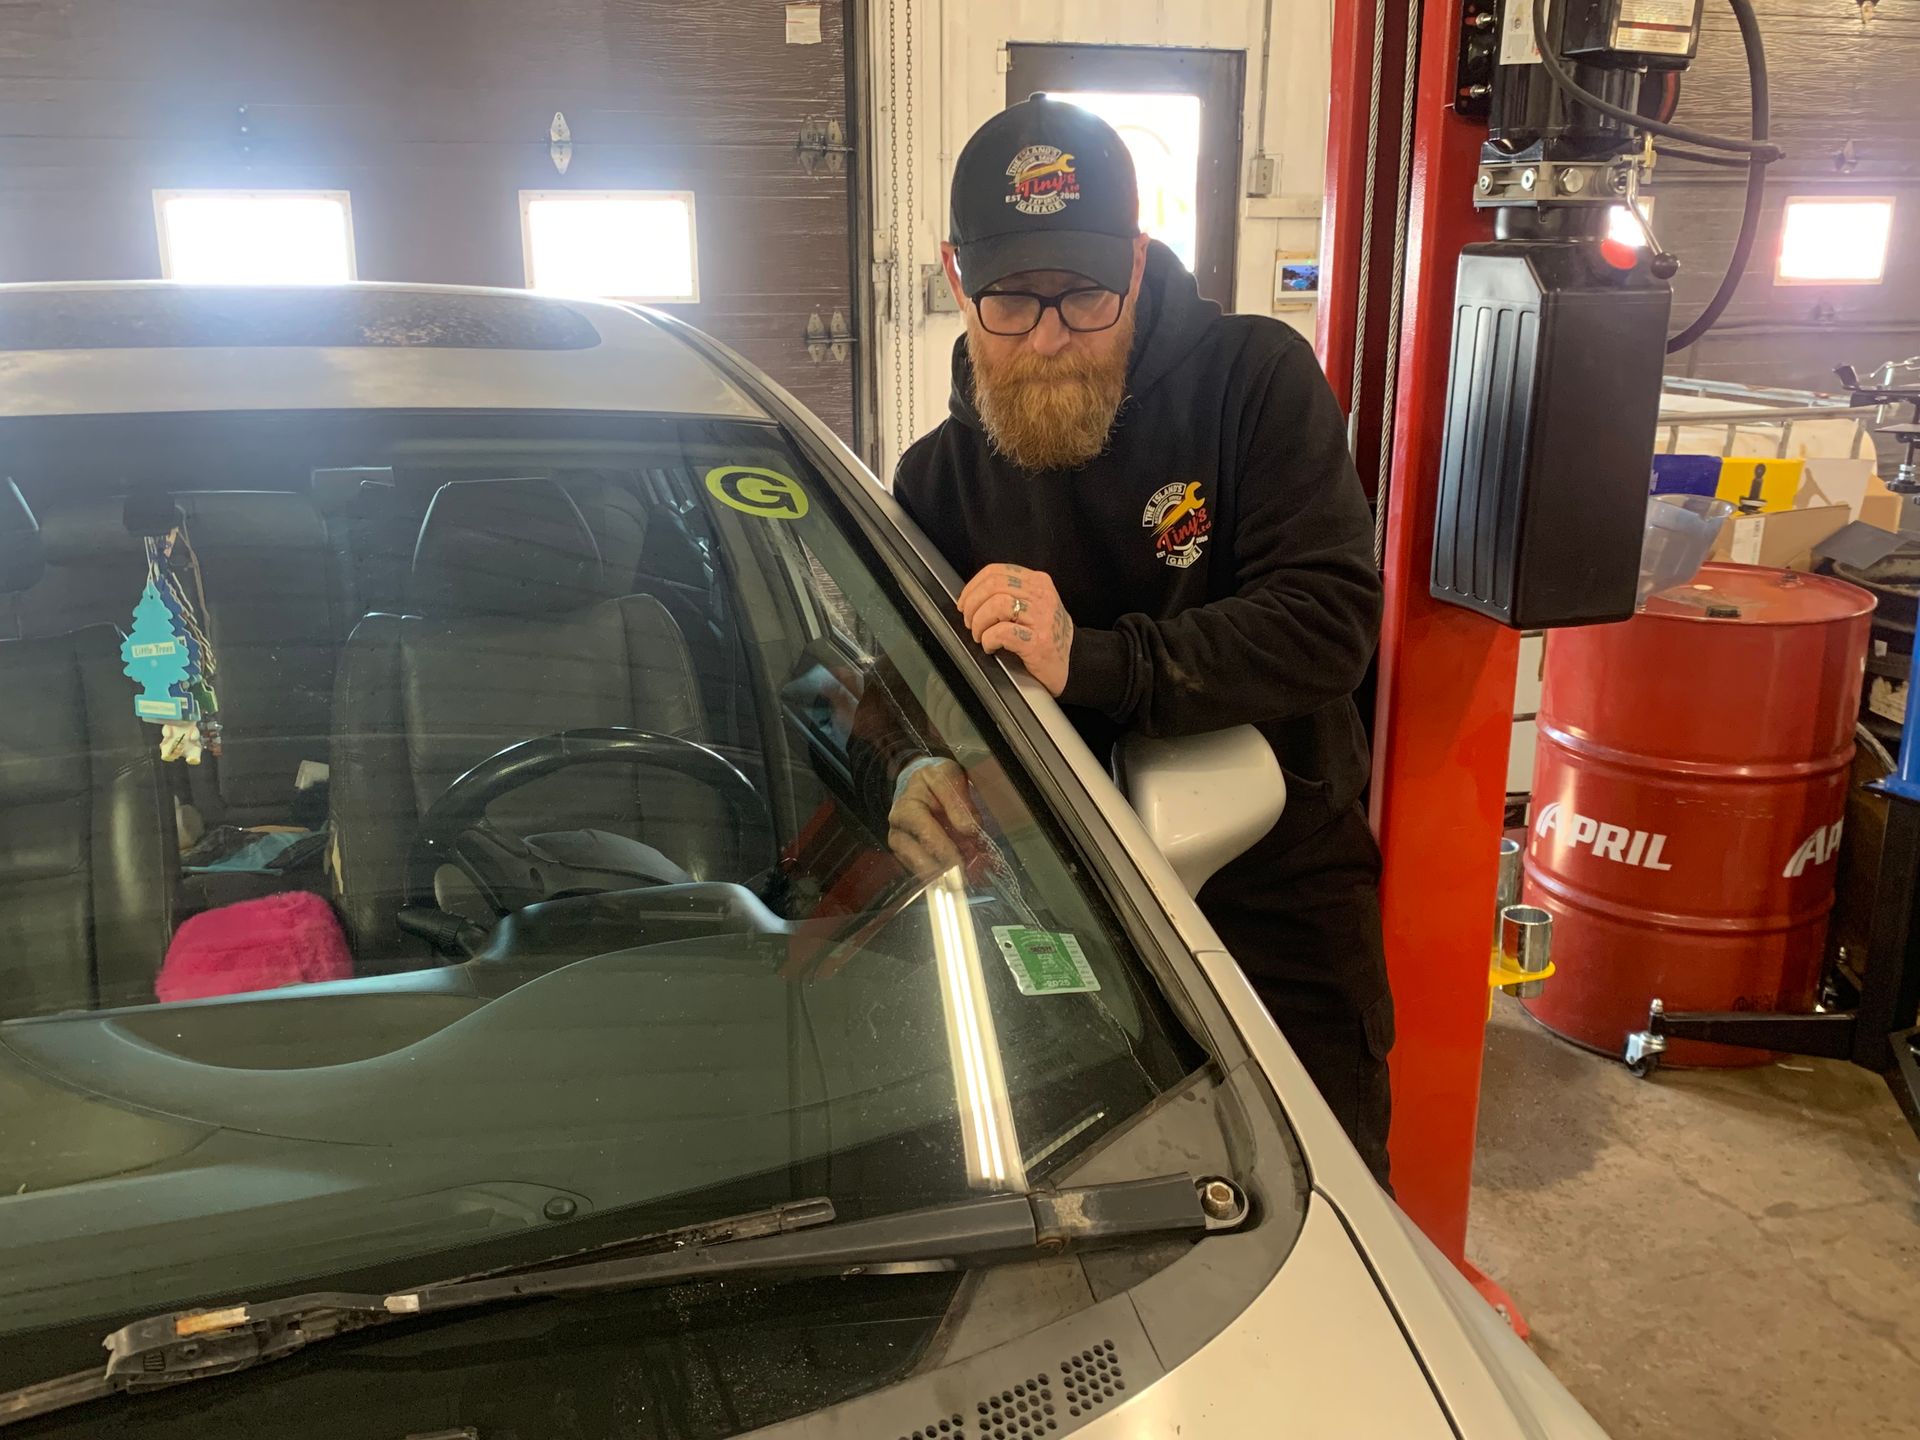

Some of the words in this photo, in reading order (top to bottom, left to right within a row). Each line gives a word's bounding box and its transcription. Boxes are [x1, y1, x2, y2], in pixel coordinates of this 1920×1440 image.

[1018, 201, 1063, 213] GARAGE
[720, 472, 799, 514] G
[1144, 505, 1156, 522] THE
[1535, 801, 1672, 871] APRIL
